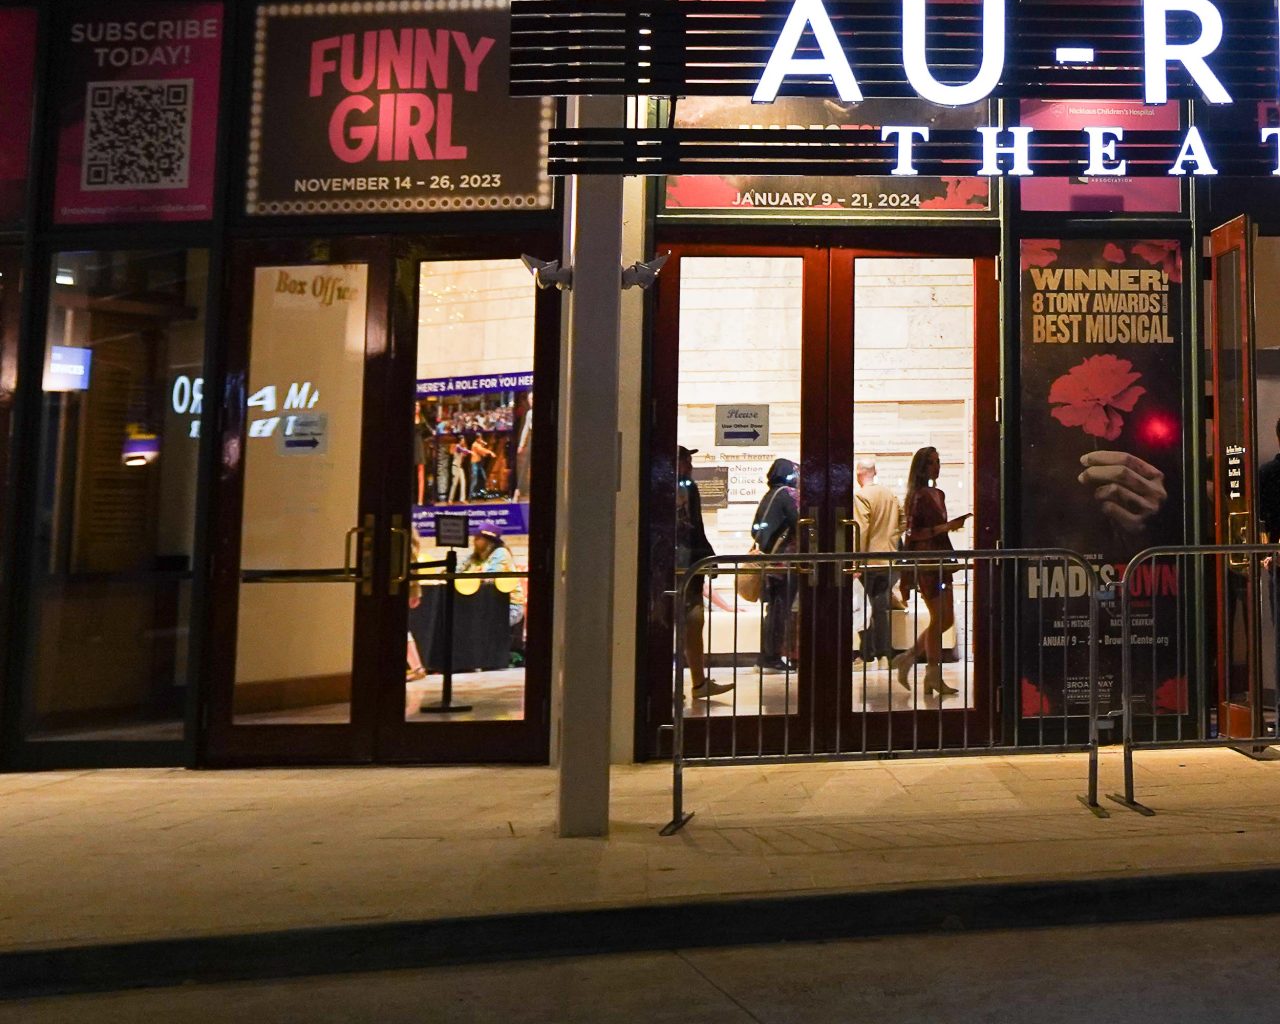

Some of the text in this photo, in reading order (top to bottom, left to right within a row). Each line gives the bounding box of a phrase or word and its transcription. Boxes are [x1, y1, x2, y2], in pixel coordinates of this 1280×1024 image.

[70, 19, 218, 42] SUBSCRIBE
[94, 45, 191, 67] TODAY!
[309, 28, 496, 97] FUNNY
[1130, 109, 1154, 117] Hospital
[328, 93, 468, 163] GIRL
[294, 177, 389, 192] NOVEMBER
[394, 176, 412, 190] 14
[429, 175, 455, 191] 26,
[459, 174, 502, 189] 2023
[732, 192, 817, 206] JANUARY
[821, 192, 832, 206] 9
[851, 193, 873, 208] 21,
[878, 193, 921, 207] 2024
[275, 270, 307, 294] Box
[1029, 268, 1169, 291] WINNER!
[1032, 292, 1044, 313] 8
[1046, 293, 1089, 313] TONY
[1092, 293, 1161, 313] AWARDS
[1033, 314, 1174, 343] BEST MUSICAL
[416, 381, 446, 392] HERE'S
[455, 379, 478, 391] ROLE
[479, 378, 498, 388] FOR
[499, 377, 517, 387] YOU
[518, 375, 533, 386] HER
[726, 408, 759, 420] Please
[705, 452, 740, 462] AuRene
[1027, 563, 1180, 599] HADSOWN
[1071, 620, 1091, 628] MITCHE
[1040, 636, 1071, 647] ANUAR
[1066, 680, 1114, 689] BROAWAY
